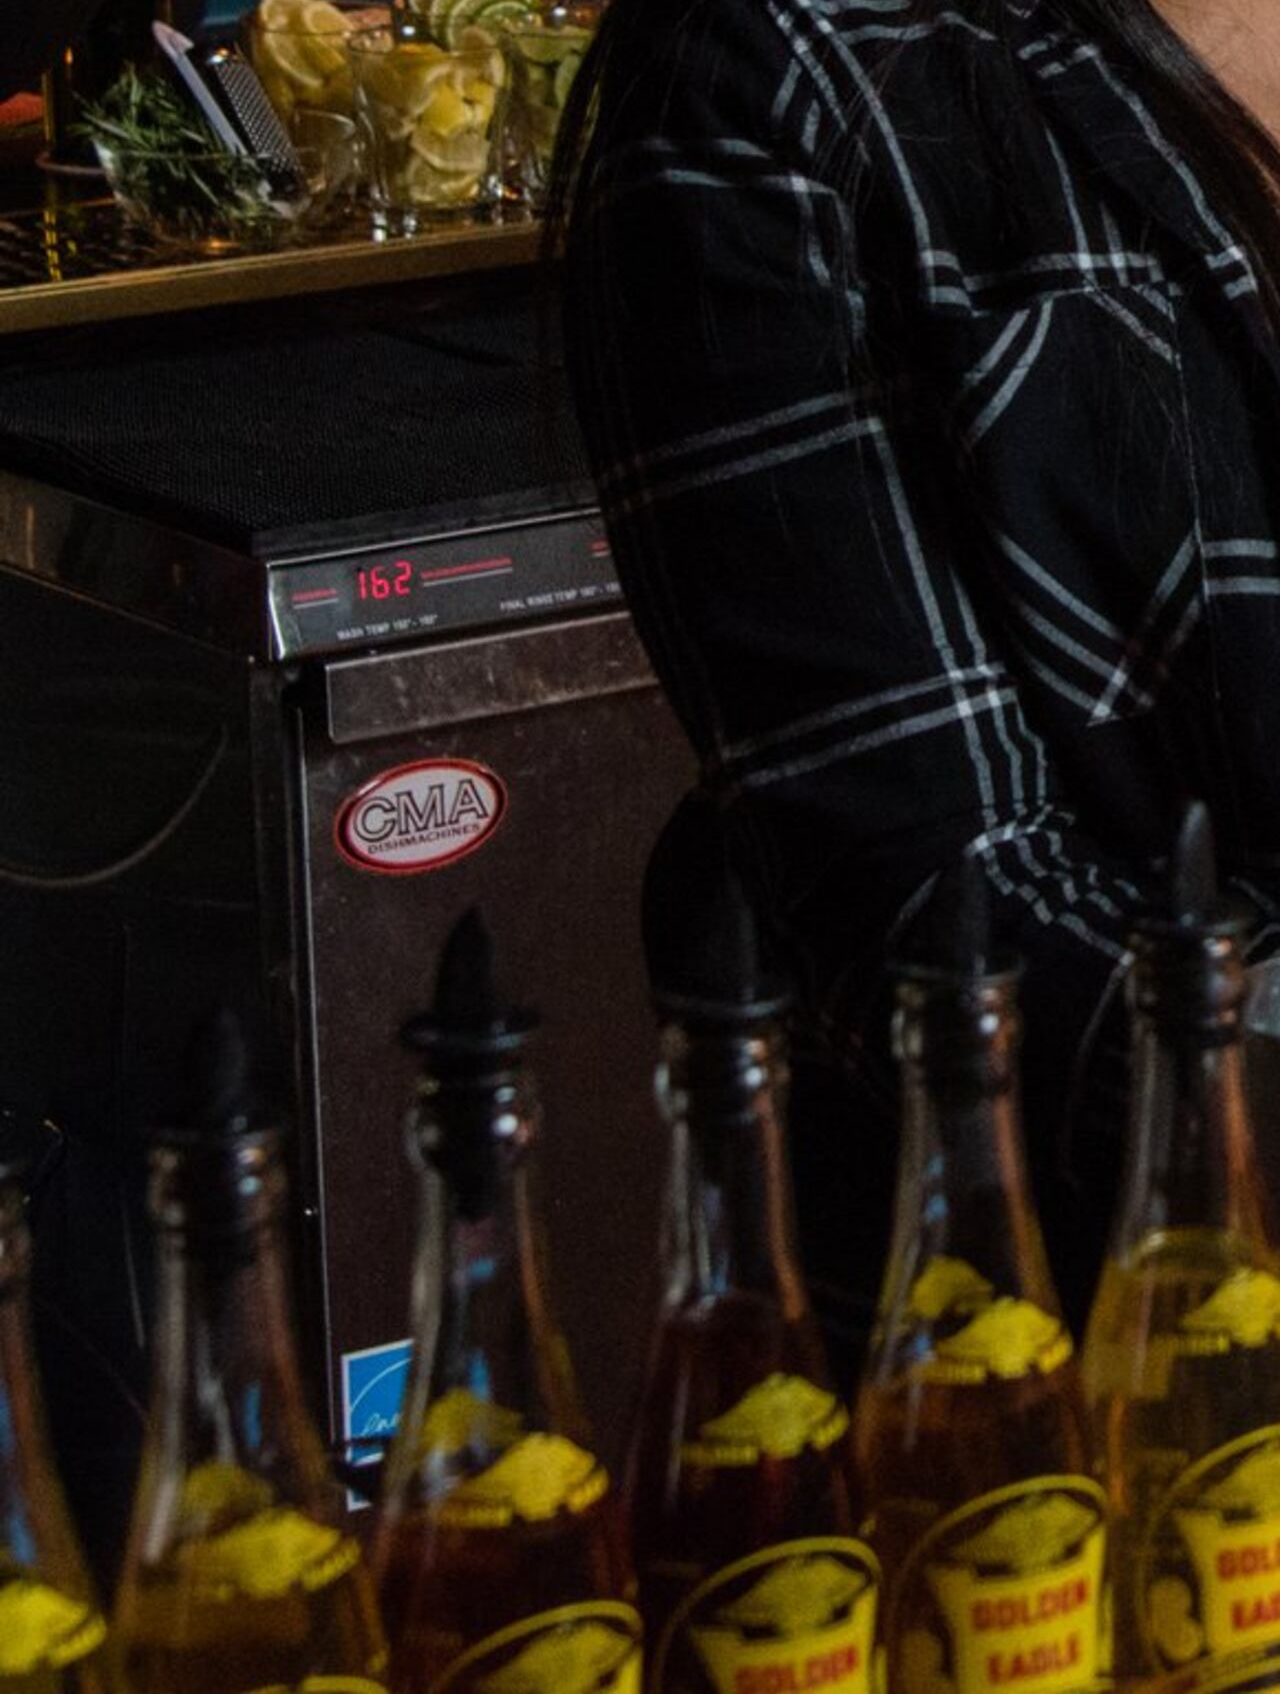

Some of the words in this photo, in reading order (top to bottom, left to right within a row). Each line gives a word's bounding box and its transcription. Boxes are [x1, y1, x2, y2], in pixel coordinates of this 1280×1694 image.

[355, 560, 414, 602] 162
[353, 777, 490, 844] CMA
[367, 823, 481, 855] DISHMACHINES
[971, 1577, 1090, 1635] GOLDEN
[986, 1637, 1080, 1686] EAGLE
